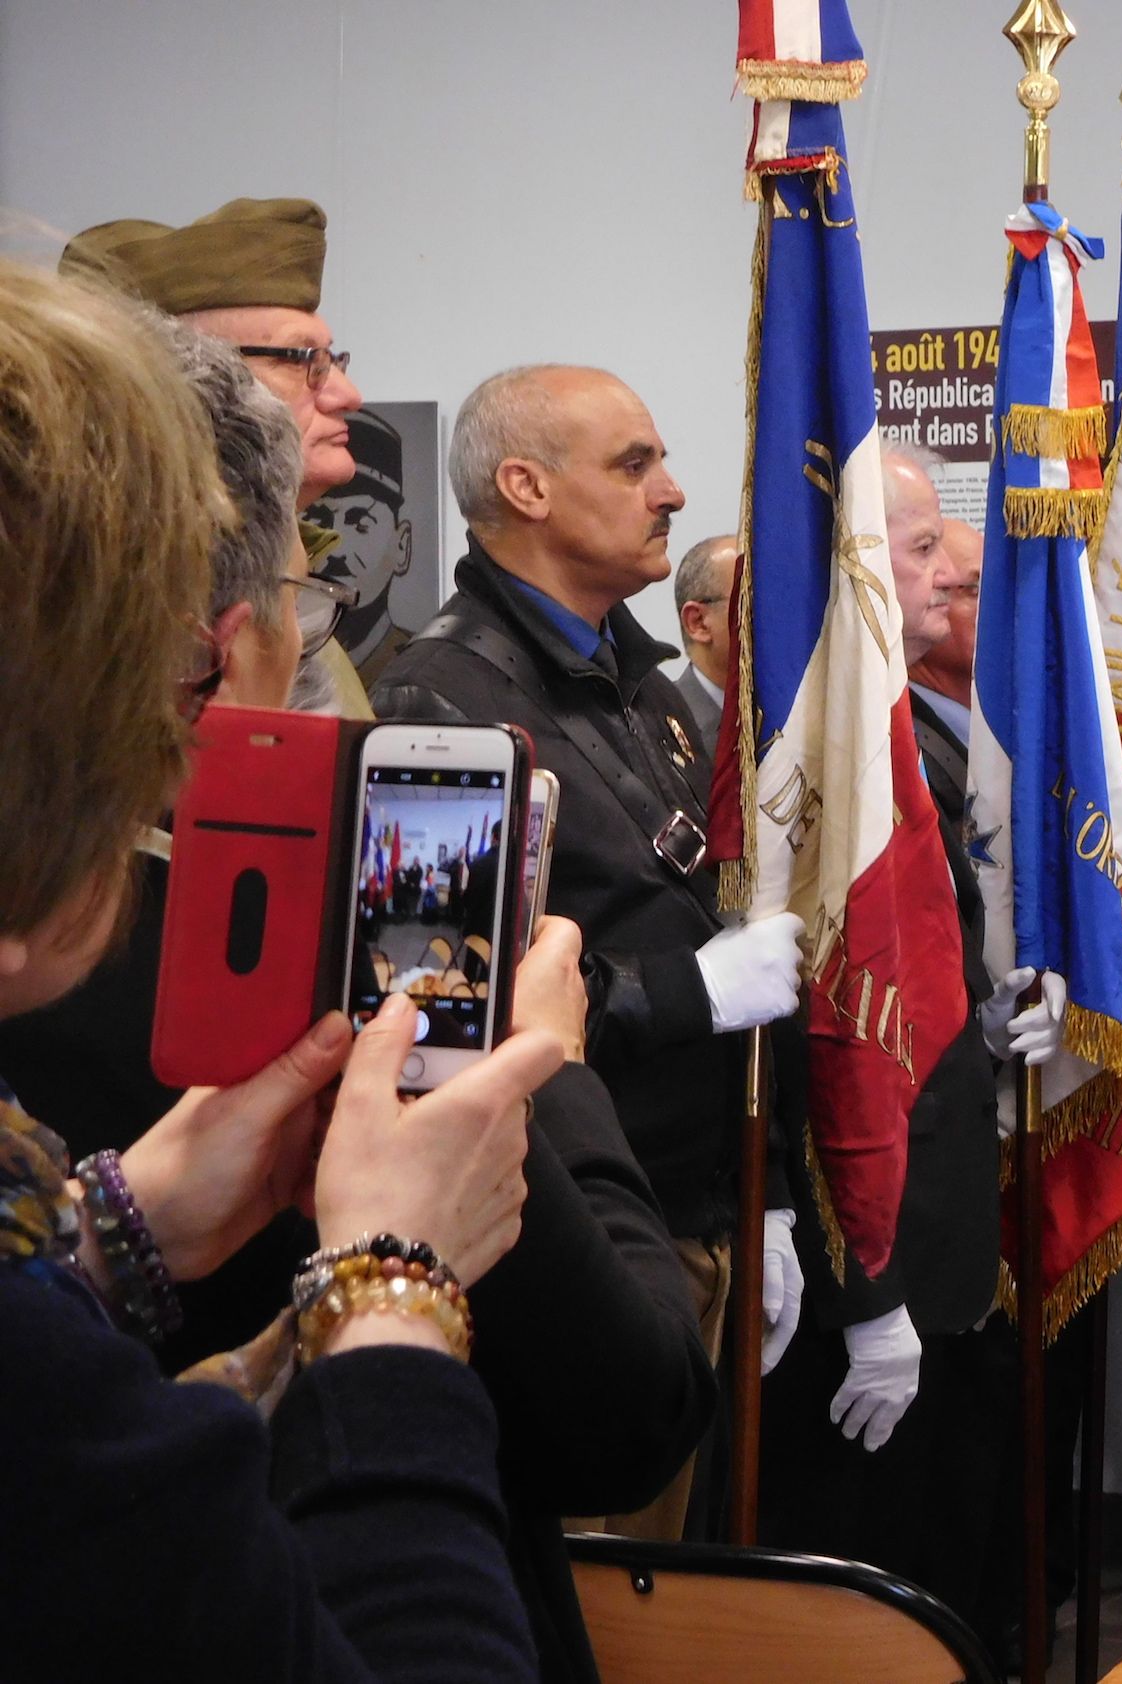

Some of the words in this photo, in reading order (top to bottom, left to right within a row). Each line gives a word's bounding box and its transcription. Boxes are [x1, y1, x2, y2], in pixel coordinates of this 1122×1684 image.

[885, 332, 945, 372] août
[953, 329, 999, 370] 194
[888, 376, 994, 417] Républica
[927, 415, 978, 446] dans
